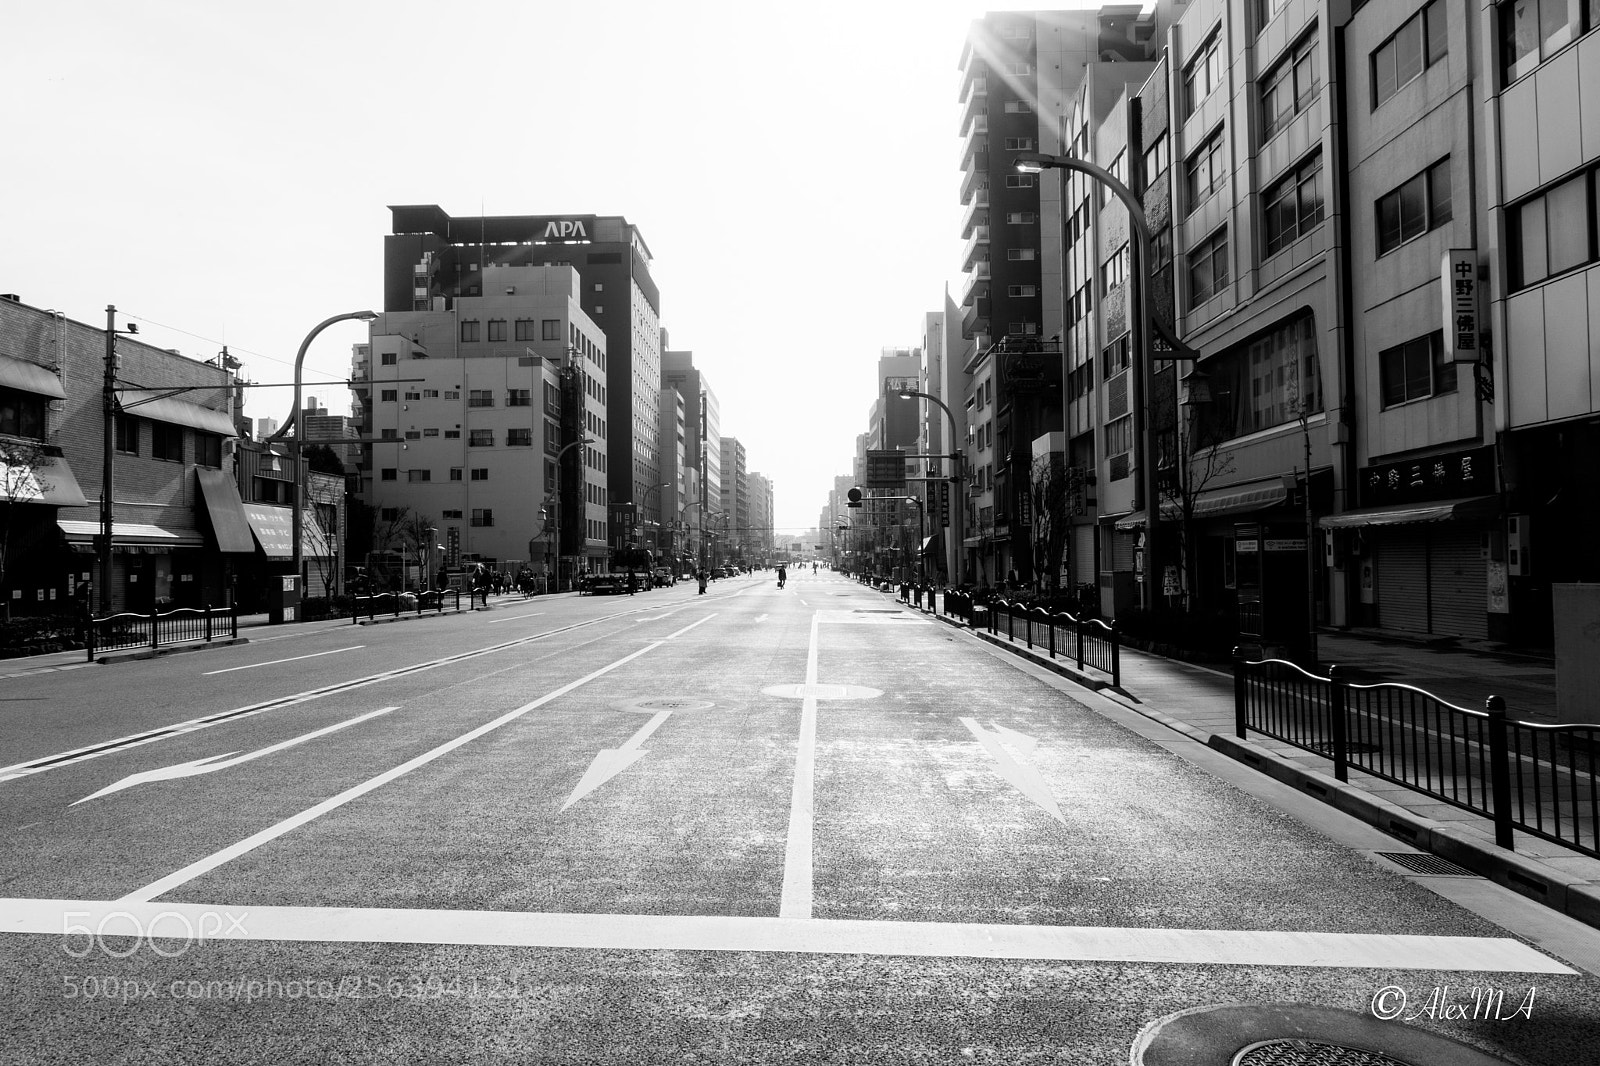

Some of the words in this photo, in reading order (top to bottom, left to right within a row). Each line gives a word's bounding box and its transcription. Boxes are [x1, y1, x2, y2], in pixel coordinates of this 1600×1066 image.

[544, 220, 587, 238] APA
[1455, 260, 1477, 350] 中野三佛屋
